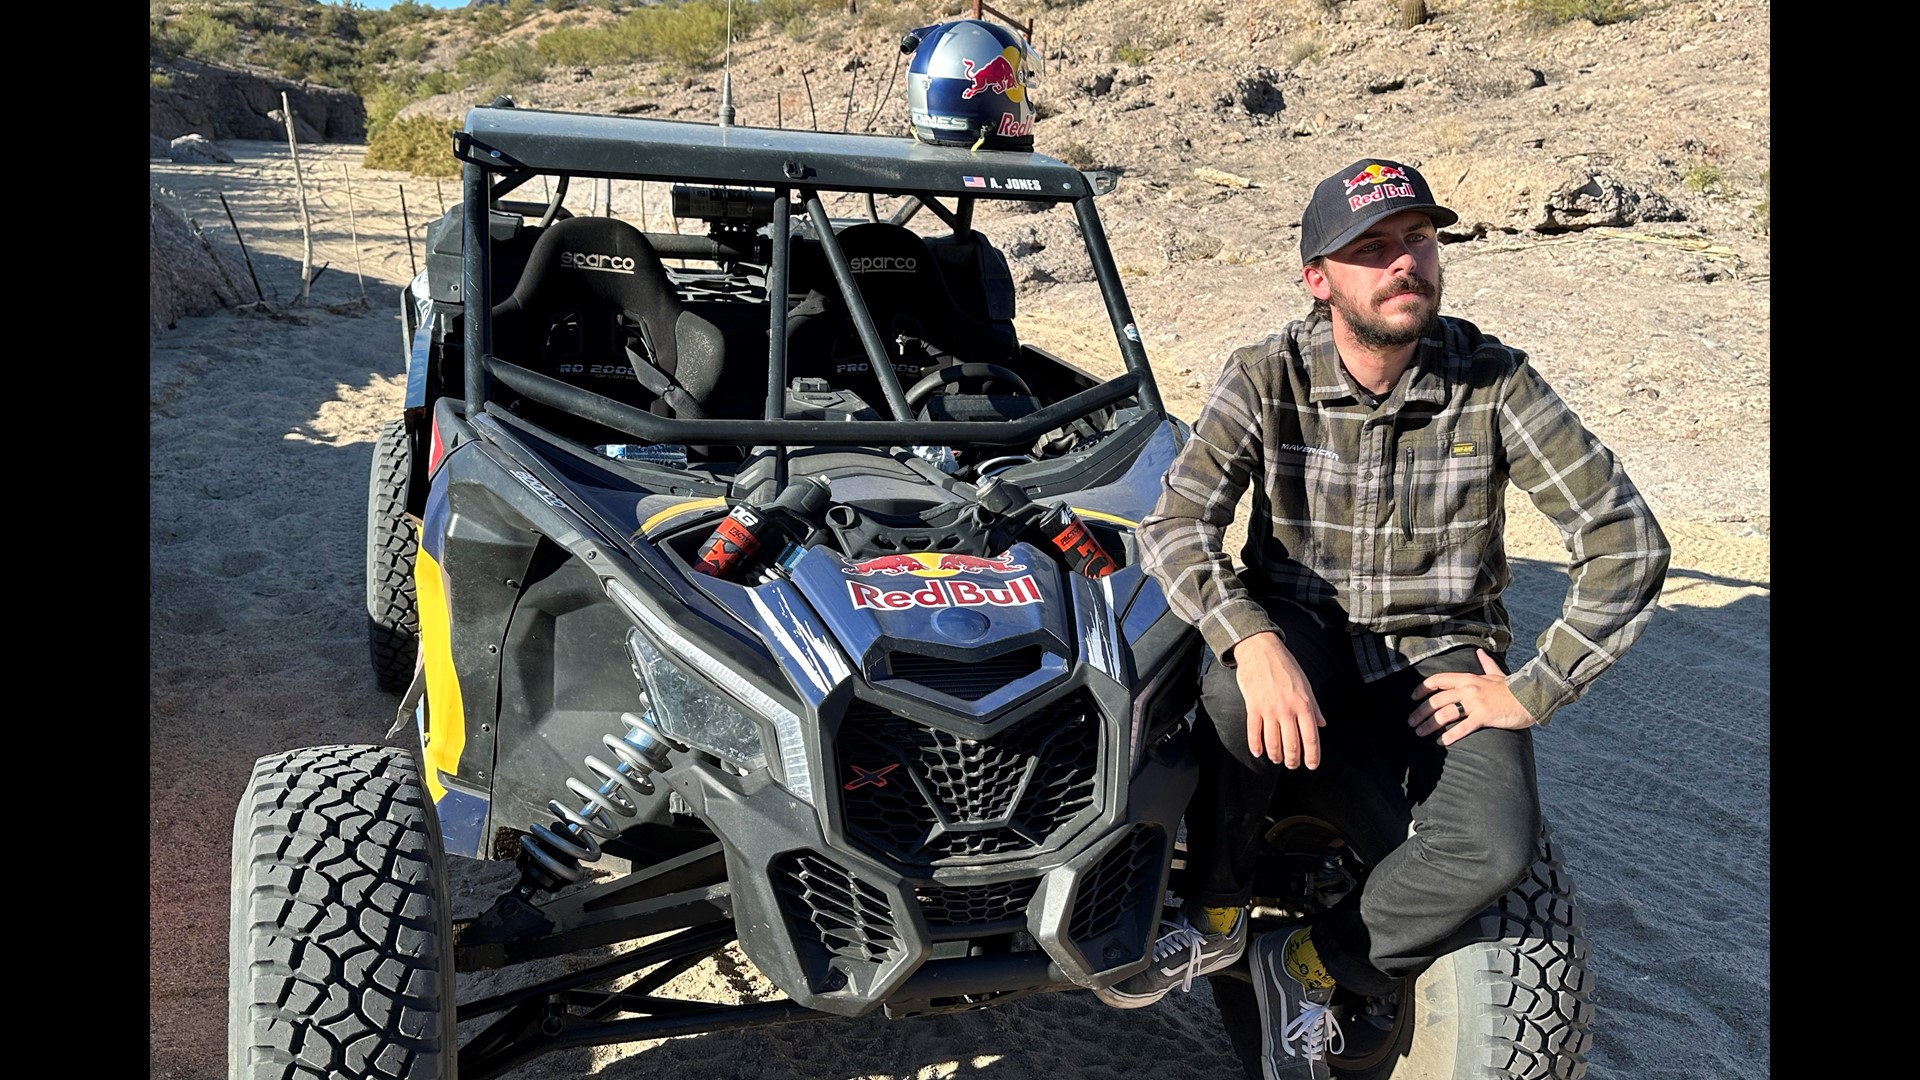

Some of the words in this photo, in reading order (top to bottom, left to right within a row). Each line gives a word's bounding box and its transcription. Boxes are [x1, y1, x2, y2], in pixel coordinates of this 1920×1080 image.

[997, 112, 1029, 137] Red
[989, 177, 1002, 189] A.
[1005, 178, 1042, 191] JONES
[1348, 185, 1384, 212] Red
[1383, 183, 1415, 199] Bull
[561, 251, 635, 273] sparco
[850, 257, 917, 273] sparco
[559, 364, 584, 373] RO
[836, 363, 869, 373] PRO
[846, 580, 950, 611] Red
[944, 575, 1044, 607] Bull
